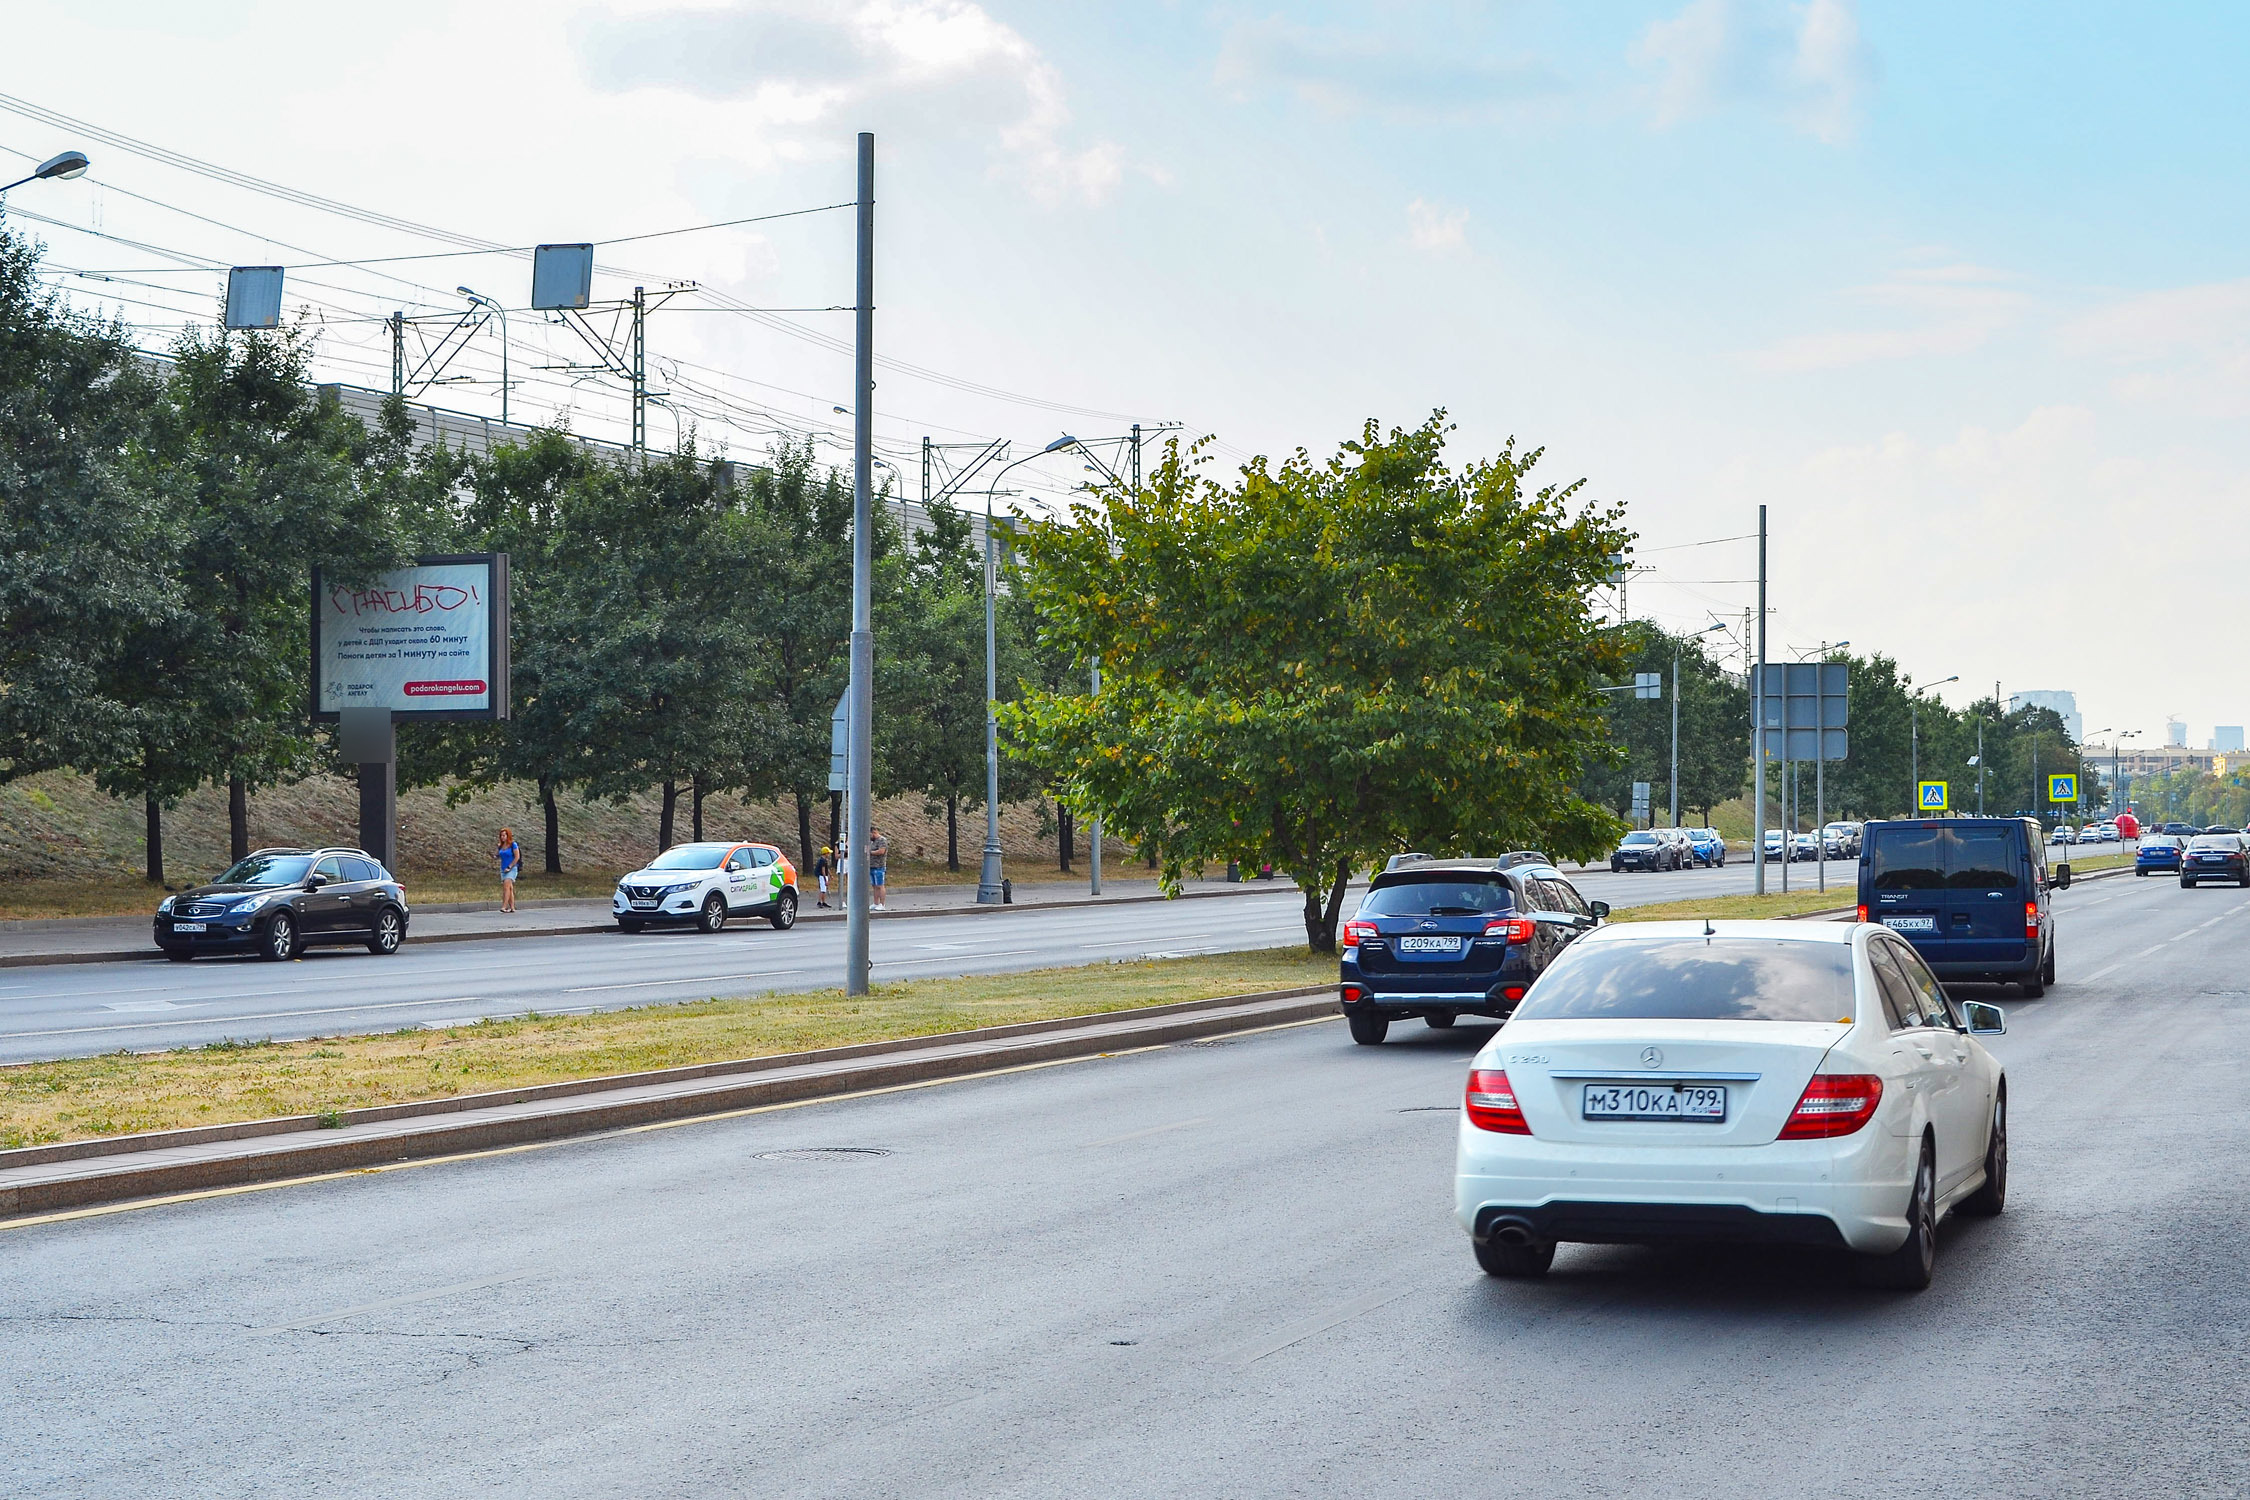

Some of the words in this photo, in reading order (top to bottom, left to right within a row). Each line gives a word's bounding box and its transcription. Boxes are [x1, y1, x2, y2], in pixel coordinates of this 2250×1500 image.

[332, 584, 481, 616] СПАСИБО!
[343, 639, 362, 647] детей
[368, 638, 384, 647] ДЦП
[384, 638, 407, 647] уходит
[429, 635, 440, 644] 60
[442, 635, 468, 645] минут
[337, 652, 364, 660] Помоги
[365, 652, 387, 660] детям
[403, 649, 437, 660] минуту
[449, 648, 470, 657] сайте
[410, 684, 480, 695] podarokangelu.com
[1403, 938, 1442, 949] С209КА
[1442, 937, 1459, 945] 799
[1590, 1089, 1680, 1112] М310КА
[1683, 1089, 1719, 1107] 799
